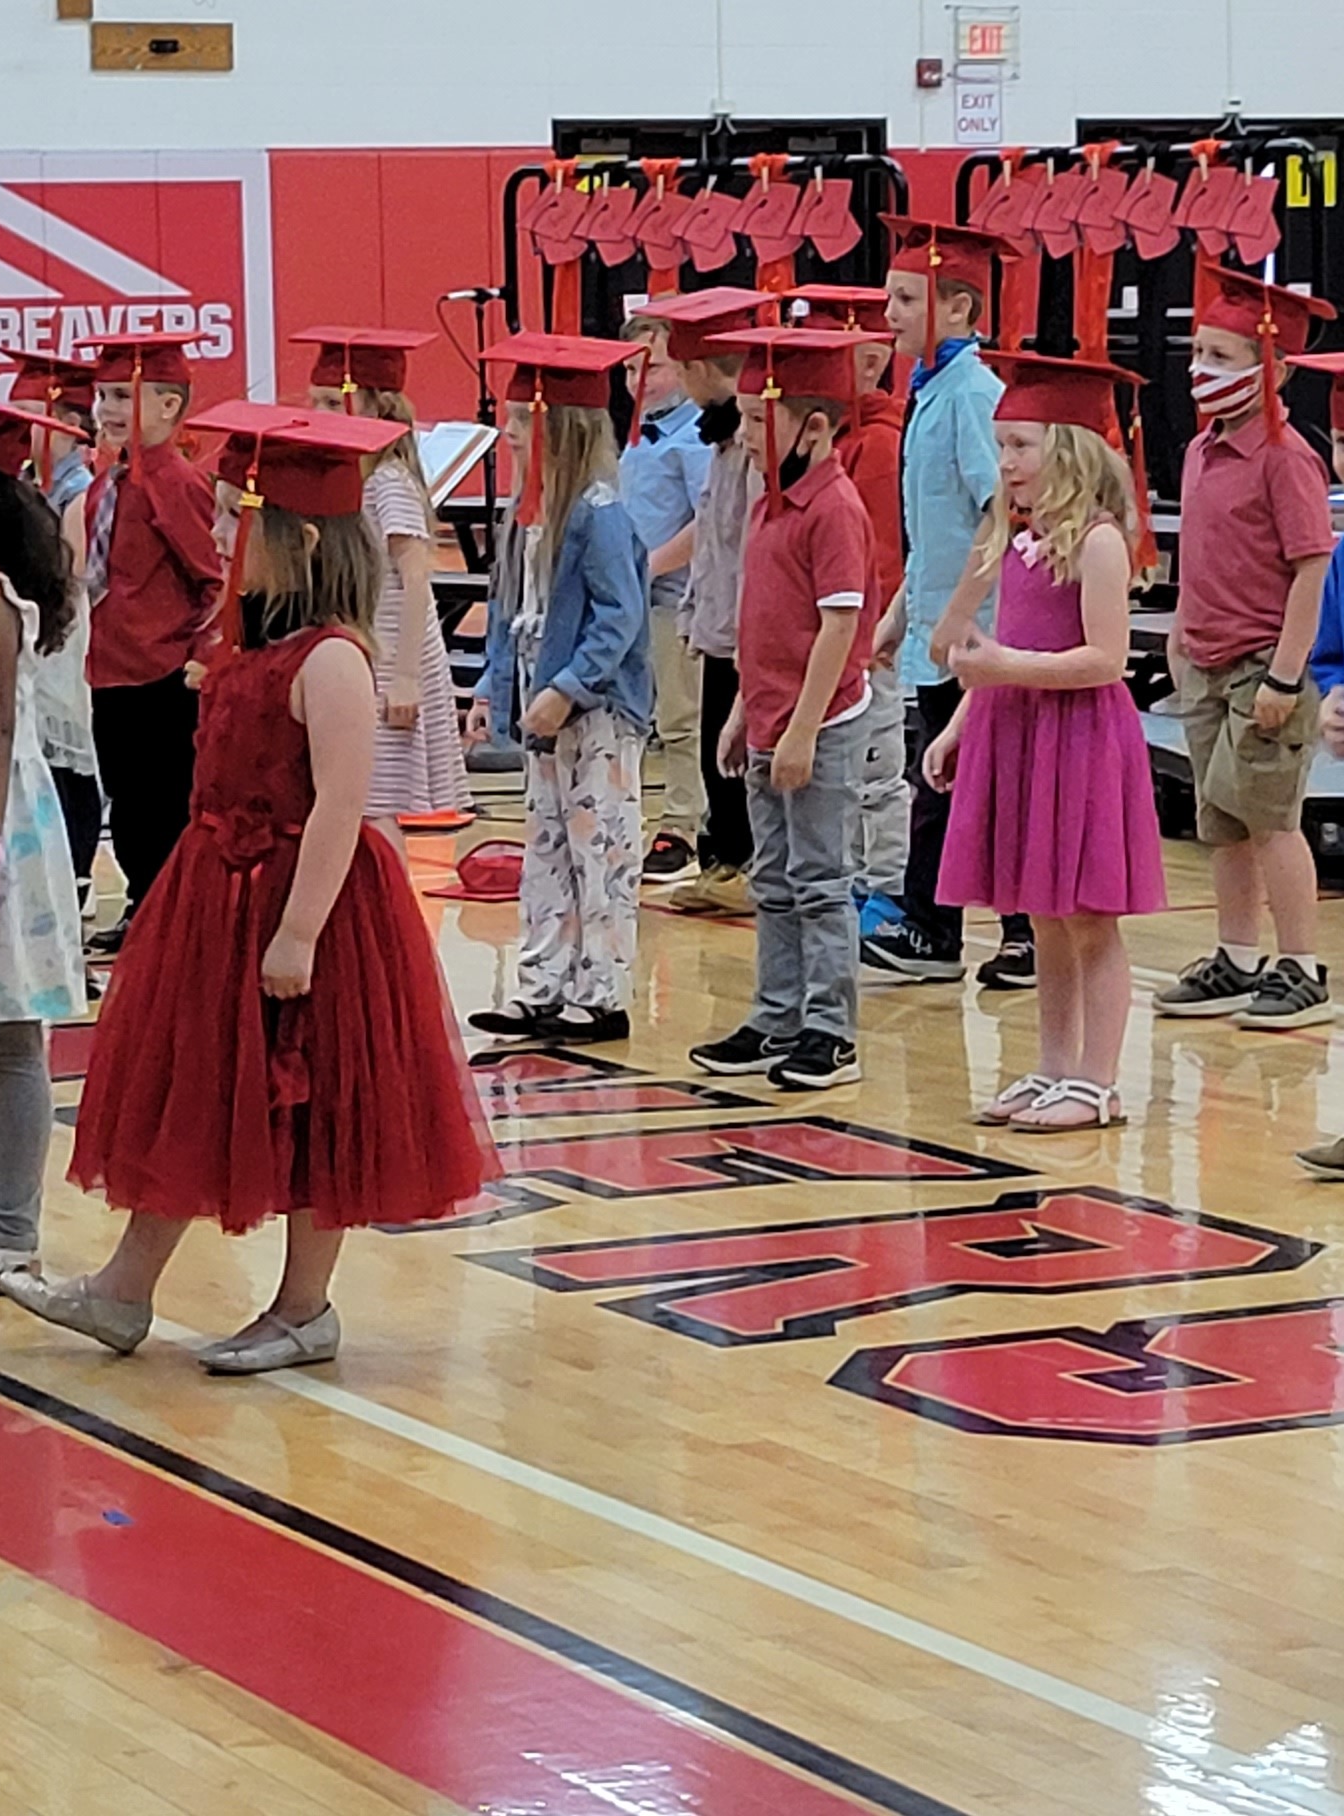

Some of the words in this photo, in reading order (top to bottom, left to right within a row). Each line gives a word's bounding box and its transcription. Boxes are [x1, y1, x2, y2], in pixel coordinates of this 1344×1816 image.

[969, 24, 1004, 55] EXIT
[961, 93, 995, 109] EXIT
[957, 116, 998, 132] ONLY
